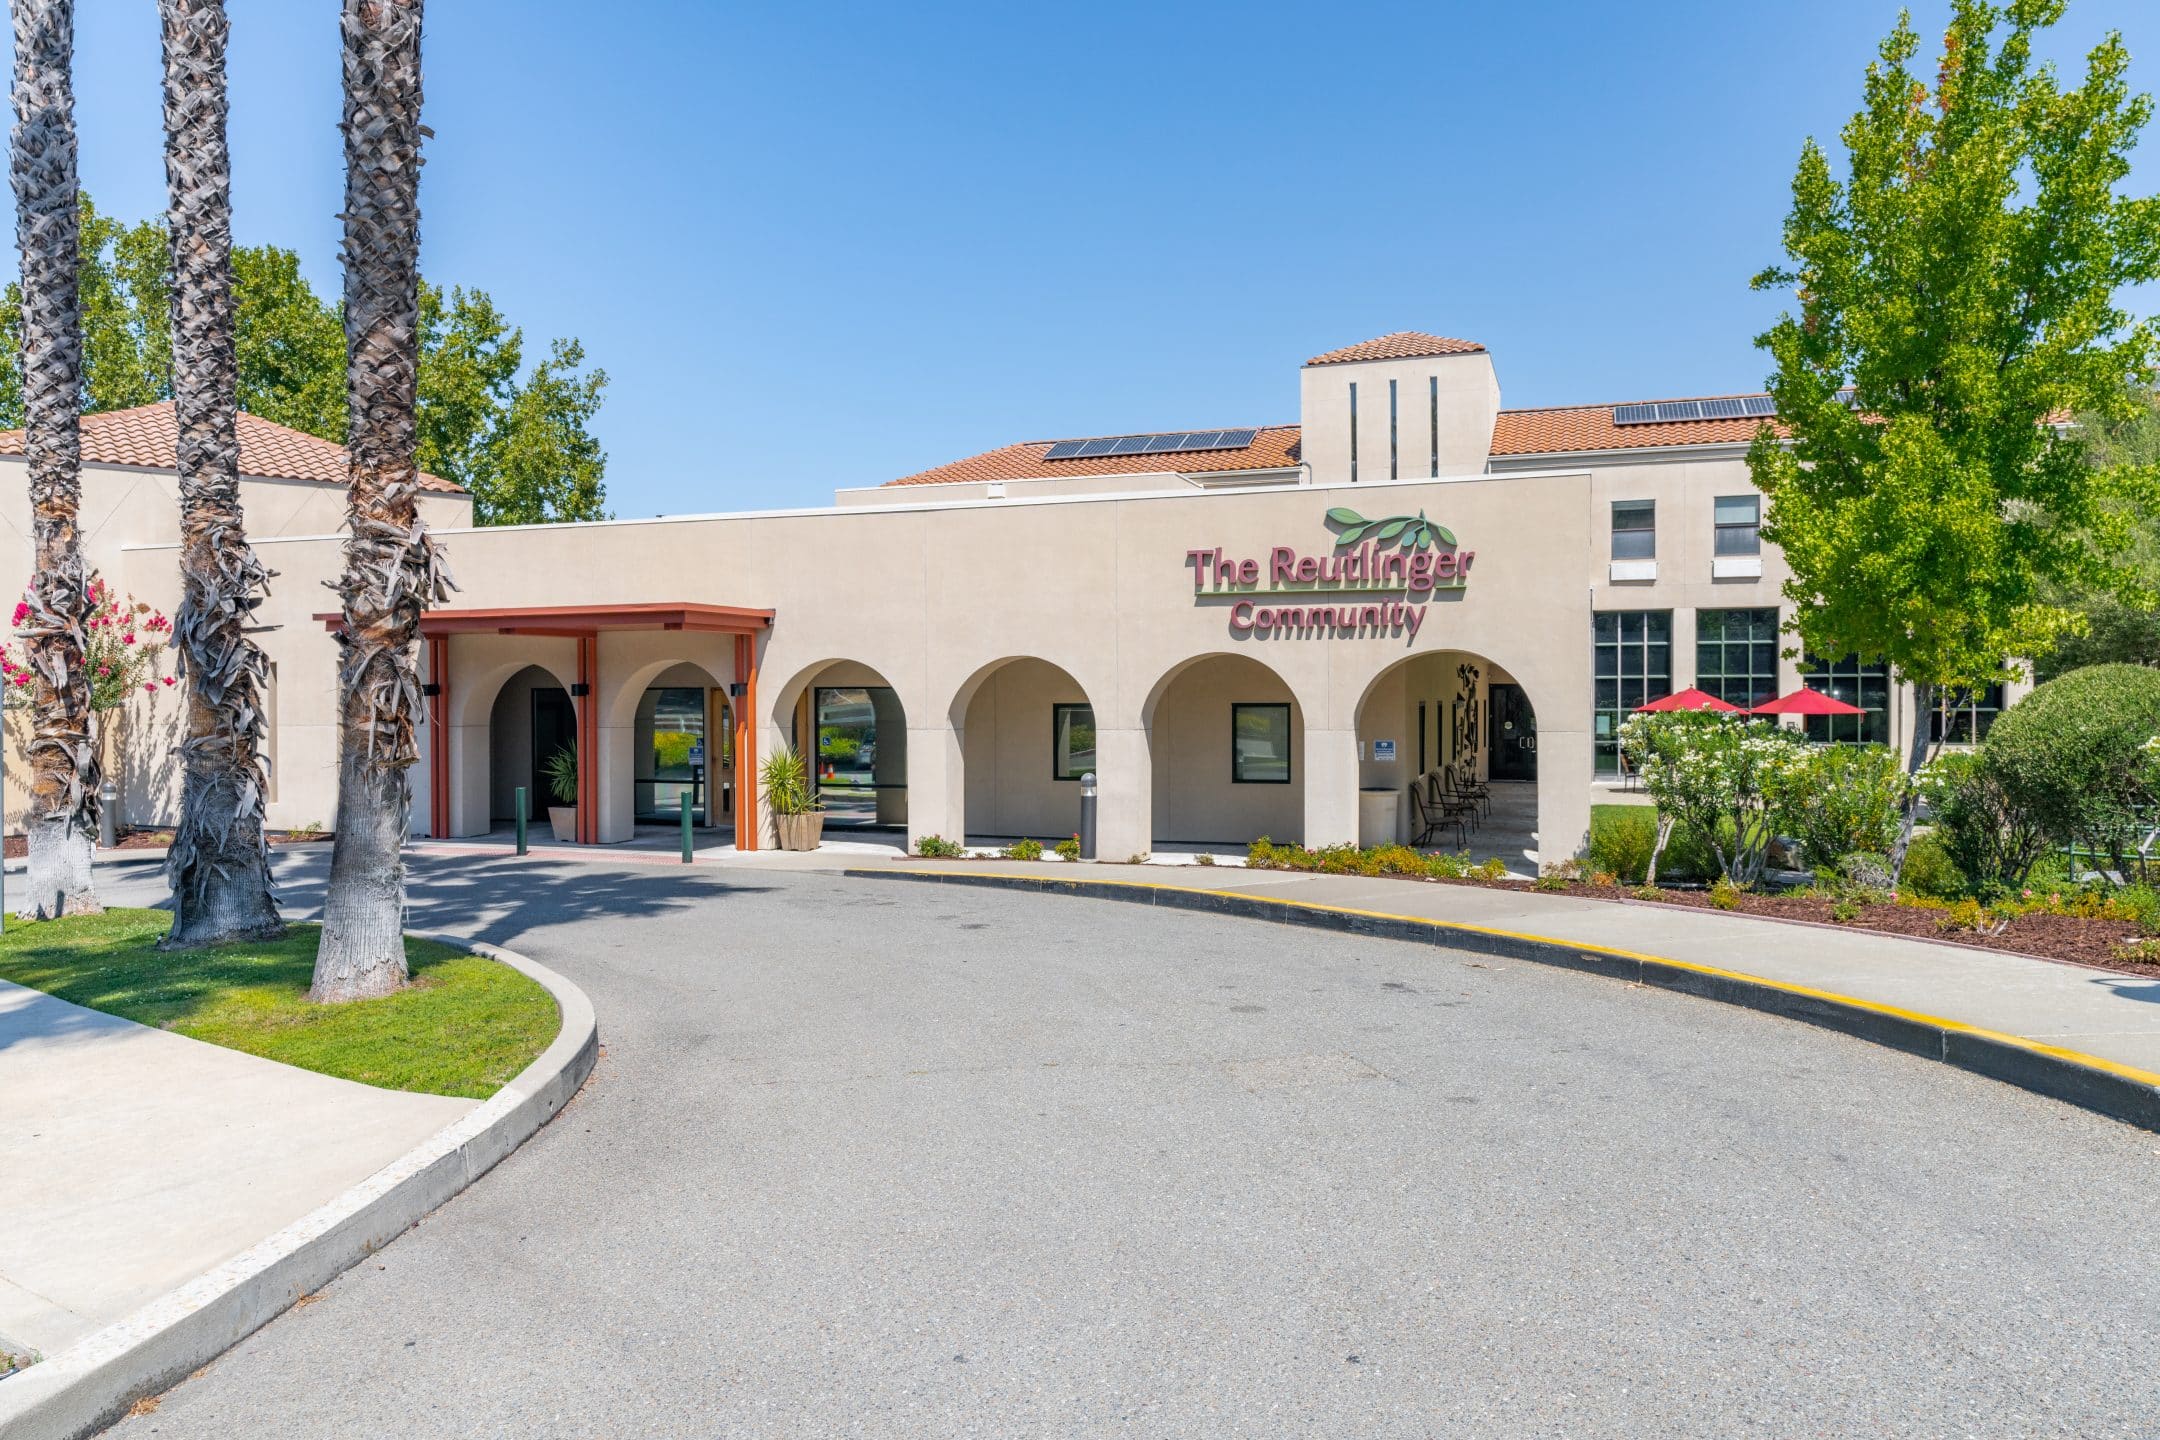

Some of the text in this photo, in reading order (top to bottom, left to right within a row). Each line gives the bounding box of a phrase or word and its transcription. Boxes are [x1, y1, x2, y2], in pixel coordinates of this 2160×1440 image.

[1187, 541, 1475, 591] The Reutlinger
[1231, 598, 1427, 636] Community
